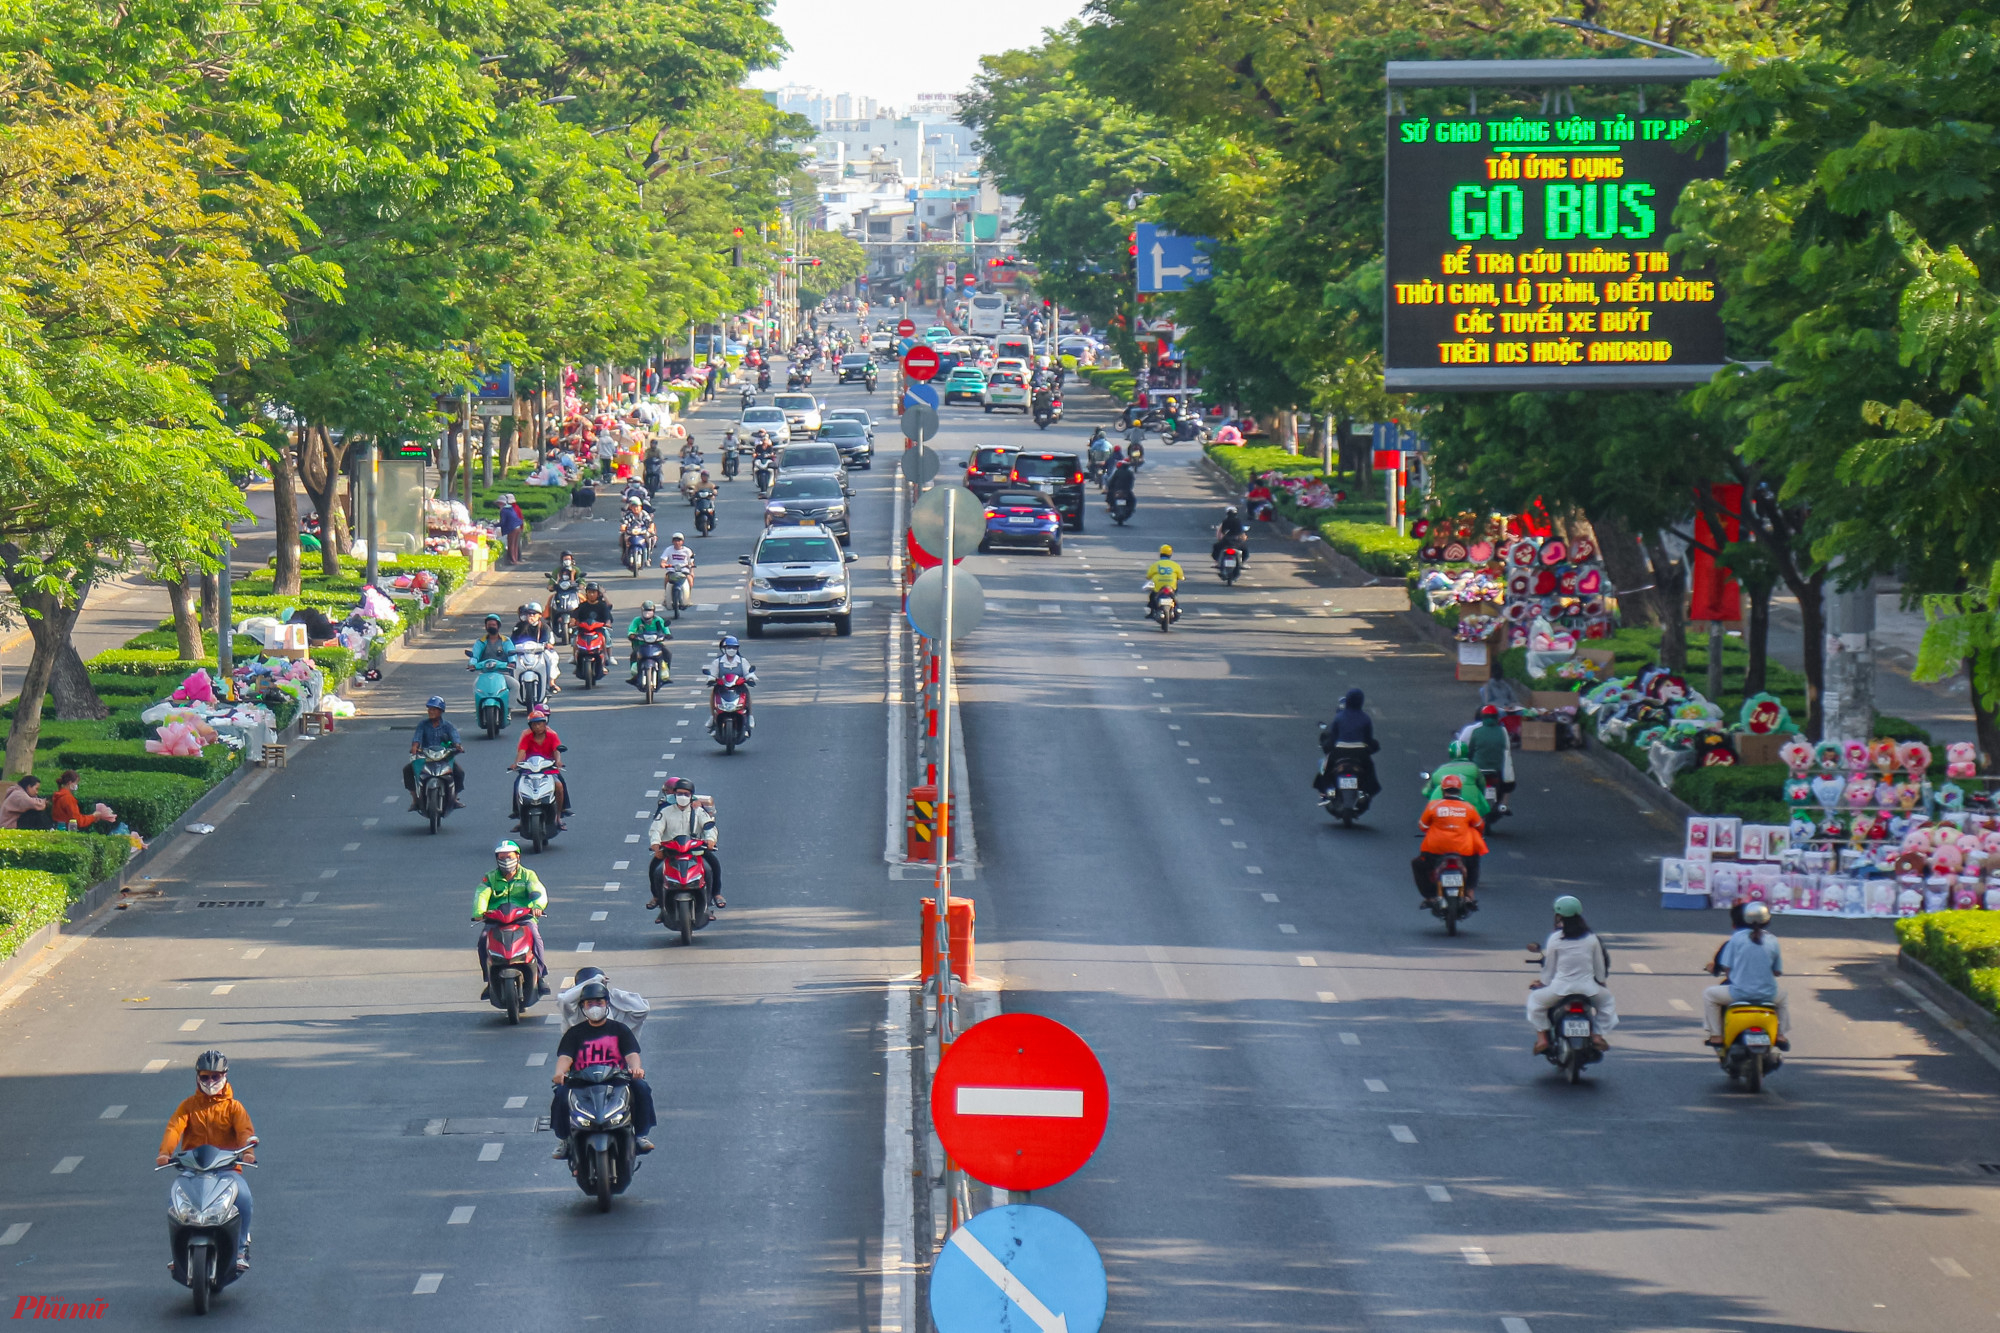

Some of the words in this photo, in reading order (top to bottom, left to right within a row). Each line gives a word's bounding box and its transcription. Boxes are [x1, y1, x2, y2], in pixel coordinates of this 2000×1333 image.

[1400, 117, 1431, 142] SỞ
[1435, 122, 1481, 142] GIAO
[1486, 117, 1550, 142] THÔNG
[1554, 116, 1595, 144] VẬN
[1601, 113, 1635, 140] TẢI
[1484, 152, 1520, 179] TẢI
[1523, 153, 1567, 179] ỨNG
[1570, 158, 1624, 181] DỤNG
[1451, 185, 1523, 240] GO
[1545, 184, 1655, 239] BUS
[1441, 245, 1472, 274] ĐỂ
[1475, 253, 1514, 274] TRA
[1518, 248, 1562, 273] CỨU
[1566, 247, 1631, 272] THÔNG
[1634, 252, 1669, 272] TIN
[1394, 279, 1444, 304] THỜI
[1448, 283, 1500, 306] GIAN,
[1503, 278, 1531, 306] LỘ
[1536, 277, 1600, 305] TRÌNH,
[1604, 273, 1654, 302] ĐIỂM
[1657, 276, 1714, 302] DỪNG
[1454, 308, 1494, 333] CÁC
[1499, 304, 1563, 333] TUYẾN
[1567, 312, 1596, 332] XE
[1600, 307, 1653, 332] BUÝT
[1438, 338, 1489, 363] TRÊN
[1495, 343, 1528, 363] IOS
[1532, 337, 1584, 365] HOẶC
[1587, 341, 1672, 362] ANDROID
